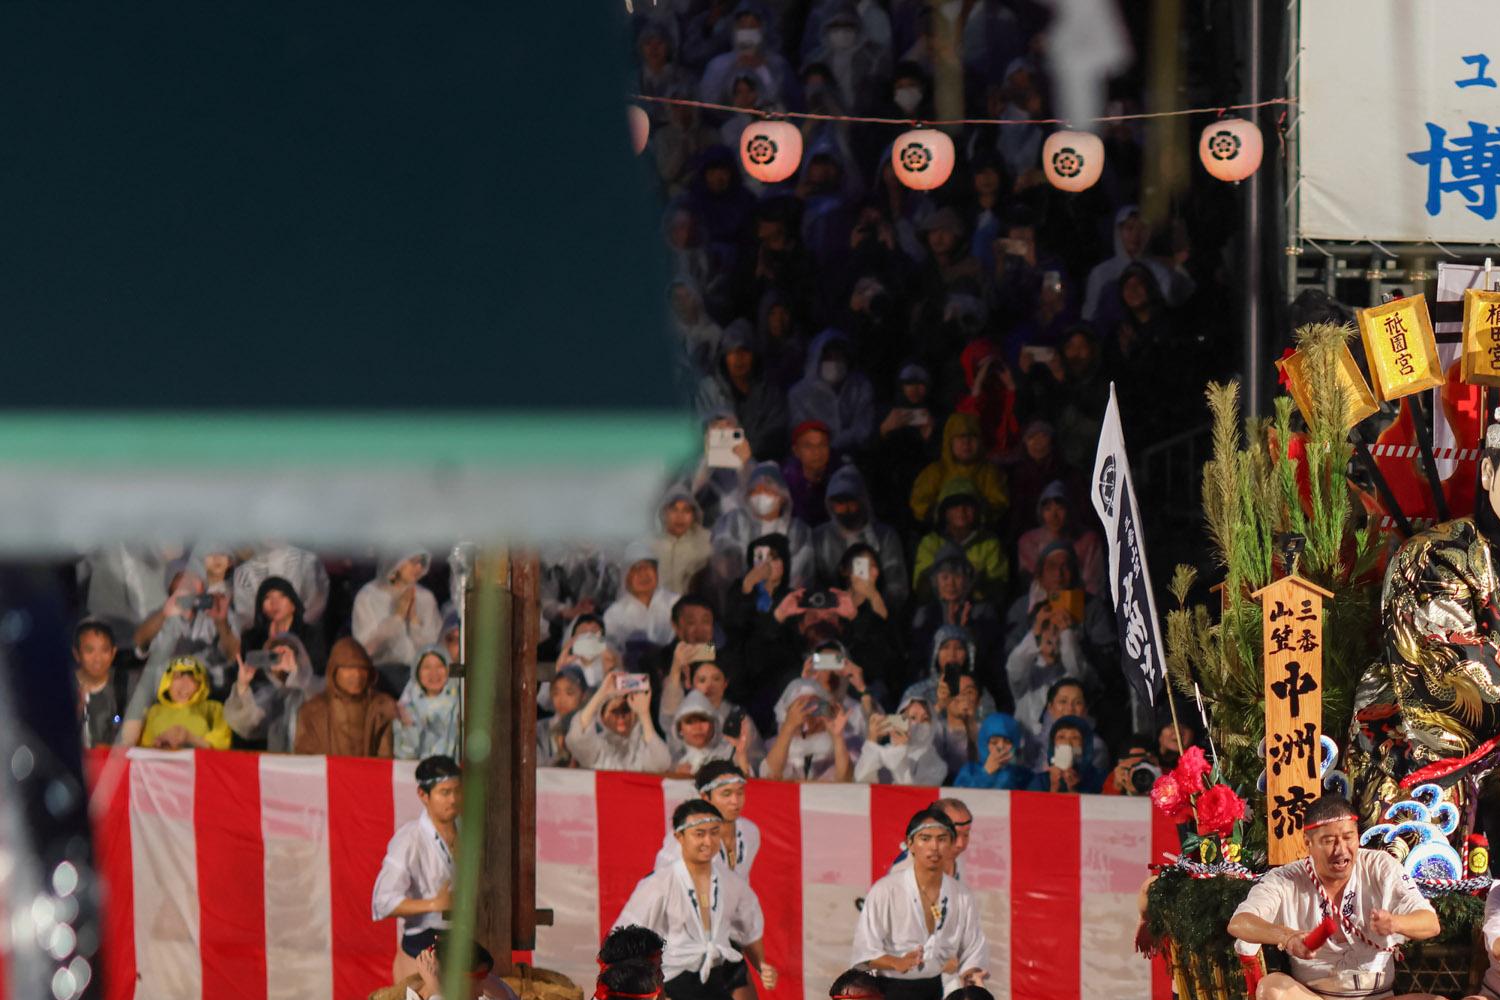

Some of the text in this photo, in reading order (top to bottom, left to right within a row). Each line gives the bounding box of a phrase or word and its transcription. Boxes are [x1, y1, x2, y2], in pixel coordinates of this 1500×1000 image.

[1384, 312, 1414, 375] 祇園宮
[1269, 601, 1296, 654] 山笠
[1296, 600, 1319, 652] 三番
